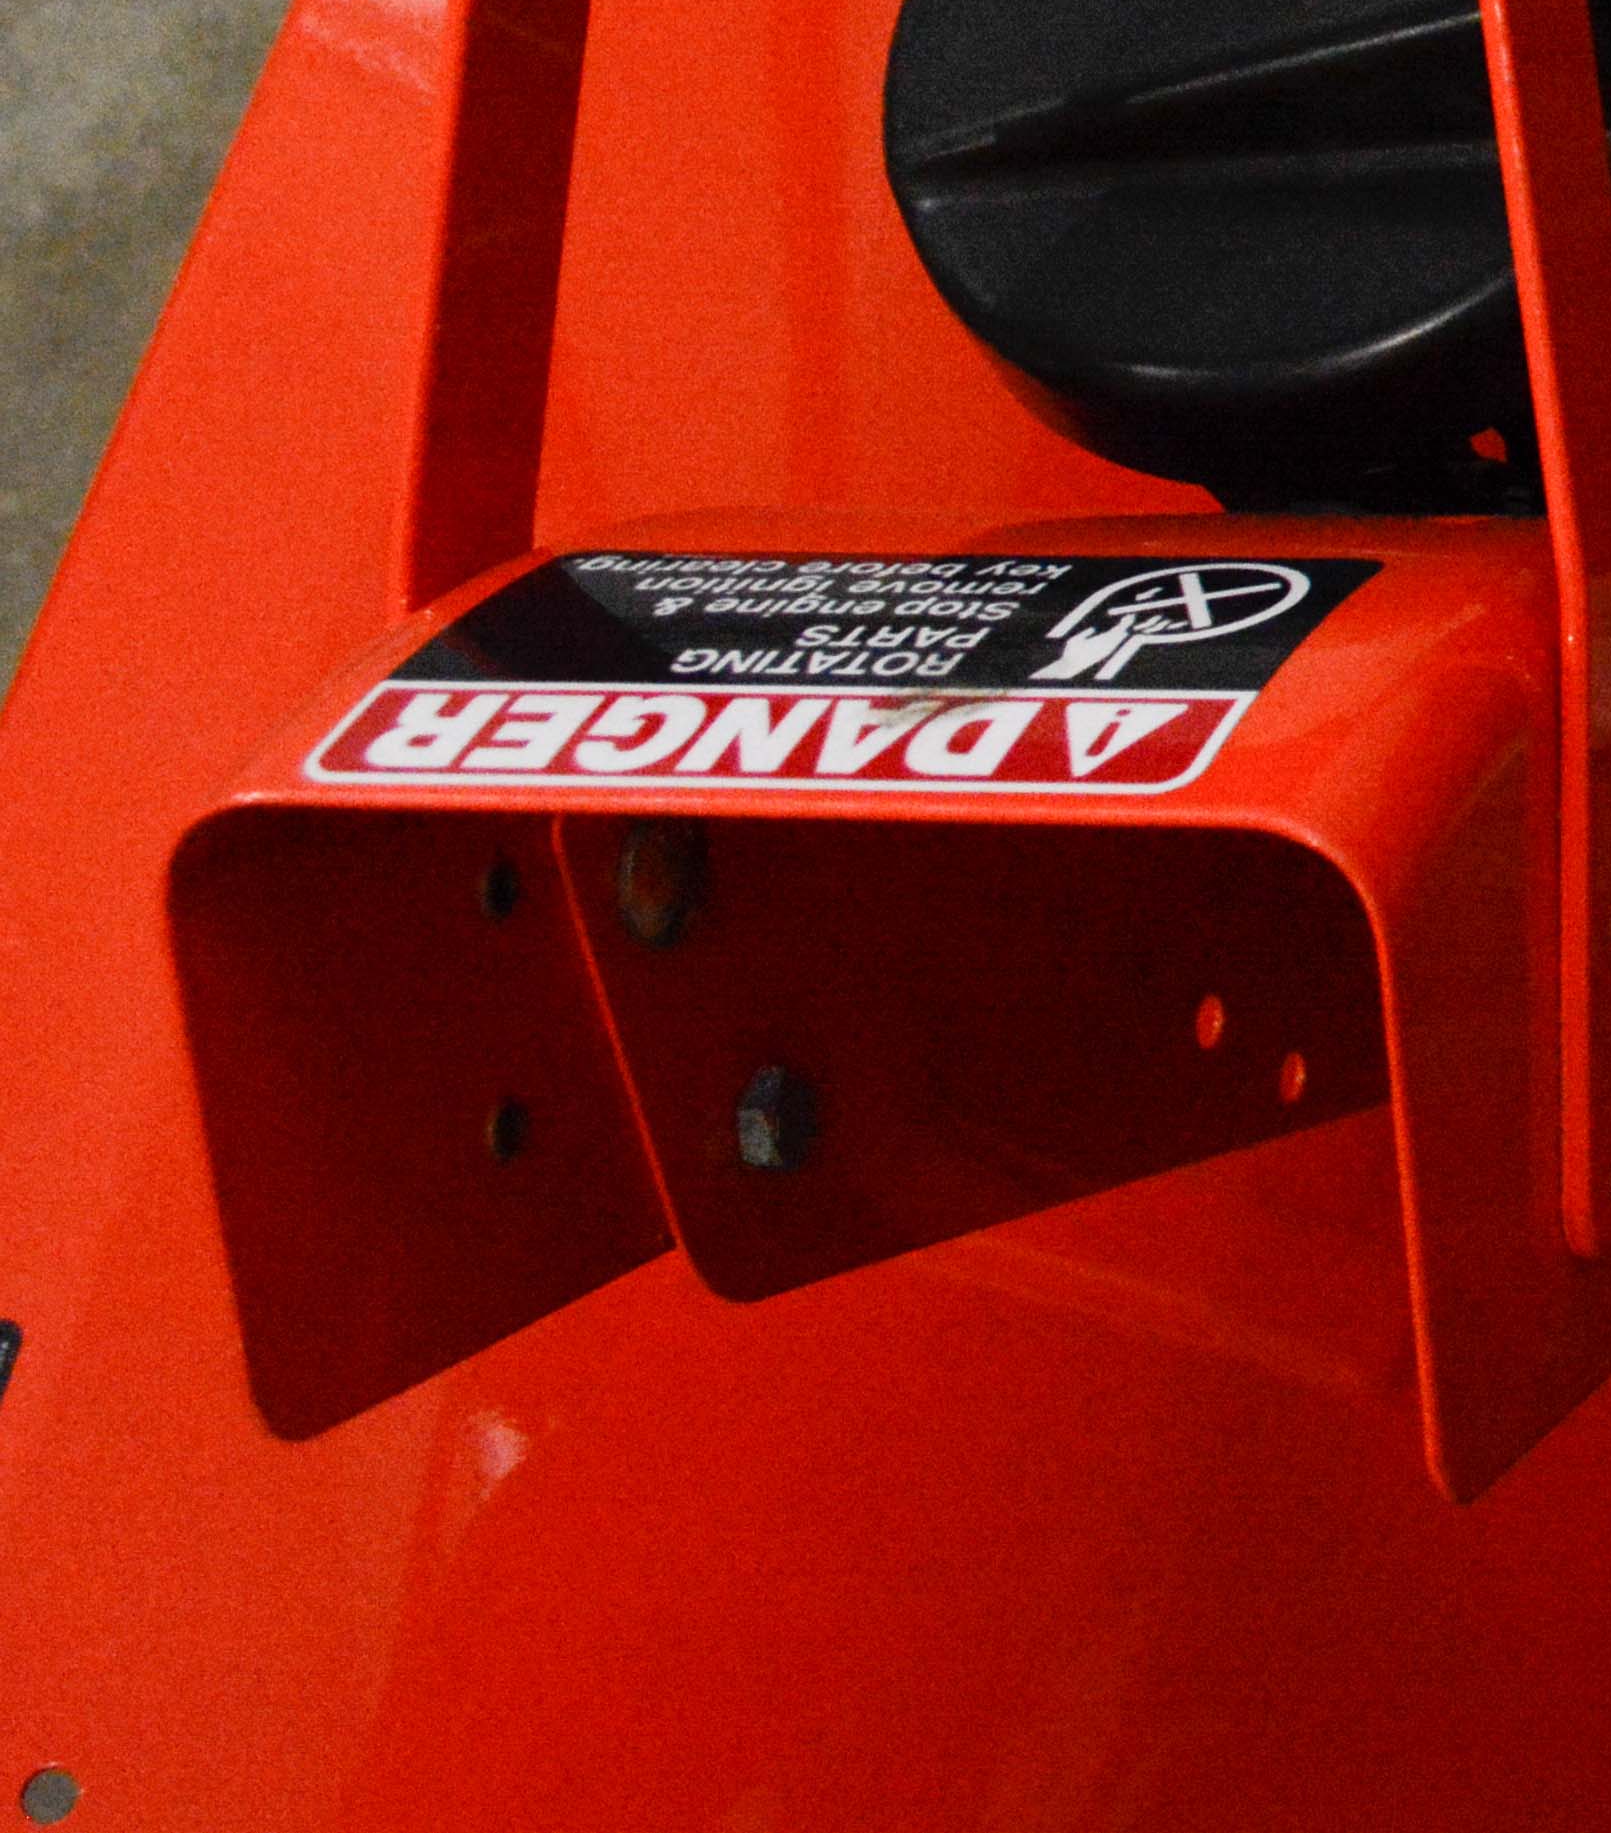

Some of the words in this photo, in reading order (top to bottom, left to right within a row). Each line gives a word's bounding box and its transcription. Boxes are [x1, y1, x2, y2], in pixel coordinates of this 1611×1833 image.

[783, 558, 973, 578] before
[976, 559, 1073, 582] key
[633, 575, 836, 599] ignition
[847, 578, 1051, 597] remove
[652, 596, 694, 619] &
[704, 595, 888, 618] engine
[893, 599, 1022, 622] Stop
[793, 623, 992, 649] PARTS
[668, 646, 965, 678] ROTATING
[361, 689, 1037, 779] DANGER
